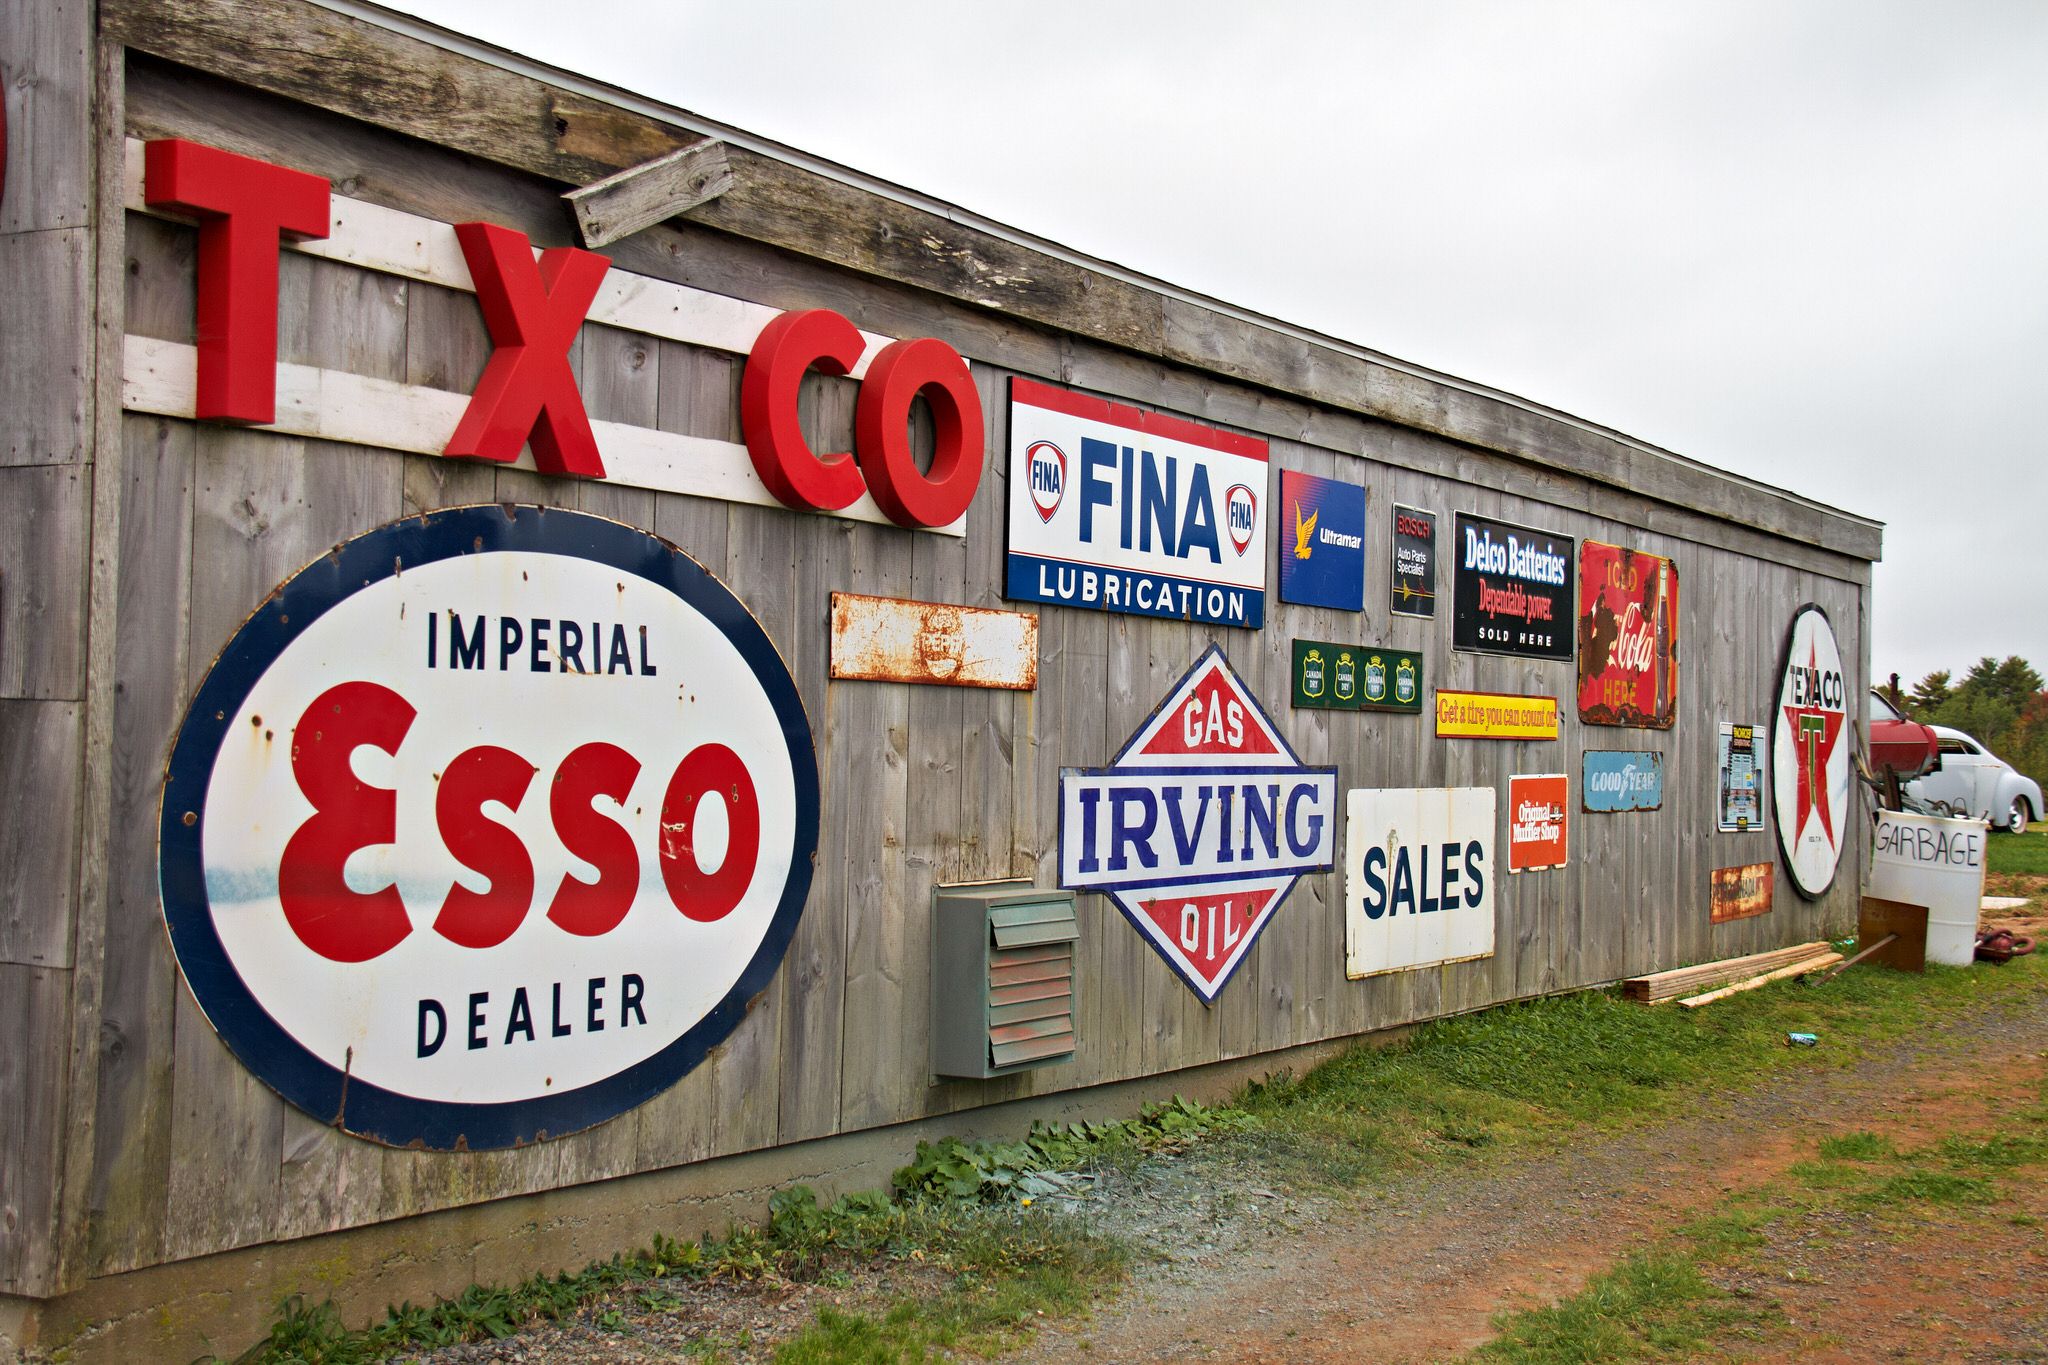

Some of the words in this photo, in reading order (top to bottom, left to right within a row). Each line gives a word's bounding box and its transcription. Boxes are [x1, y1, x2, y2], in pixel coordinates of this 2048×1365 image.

[1032, 460, 1060, 494] FINA
[1079, 436, 1222, 564] FINA
[1230, 501, 1252, 531] FINA
[1320, 528, 1362, 549] Ultramar
[1398, 515, 1430, 539] BOSCH
[1397, 560, 1424, 576] Specialist
[1398, 547, 1411, 561] Auto
[1411, 549, 1426, 564] Parts
[1465, 526, 1507, 575] Delco
[1508, 534, 1565, 585] Batteries
[1039, 564, 1243, 620] LUBRICATION
[1479, 578, 1526, 619] Dependable
[428, 611, 657, 676] IMPERIAL
[1479, 627, 1509, 642] SOLD
[1519, 632, 1552, 647] HERE
[1306, 670, 1321, 679] CANADA
[1309, 680, 1318, 688] DRY
[1338, 673, 1352, 682] CANADA
[1341, 683, 1349, 691] DRY
[1790, 665, 1841, 709] TEXACO
[1603, 678, 1637, 707] HERE
[1183, 689, 1244, 748] GAS
[1440, 698, 1458, 724] Get
[1460, 705, 1466, 723] a
[1467, 700, 1484, 724] tire
[1486, 707, 1502, 731] you
[1504, 708, 1520, 726] can
[1522, 706, 1545, 727] count
[1078, 783, 1324, 873] IRVING
[1518, 801, 1550, 824] Original
[1512, 821, 1541, 843] Muffler
[1541, 822, 1559, 844] Shop
[1875, 822, 1979, 867] GARBAGE
[1363, 840, 1484, 920] SALES
[1180, 900, 1241, 960] OIL
[417, 973, 647, 1058] DEALER
